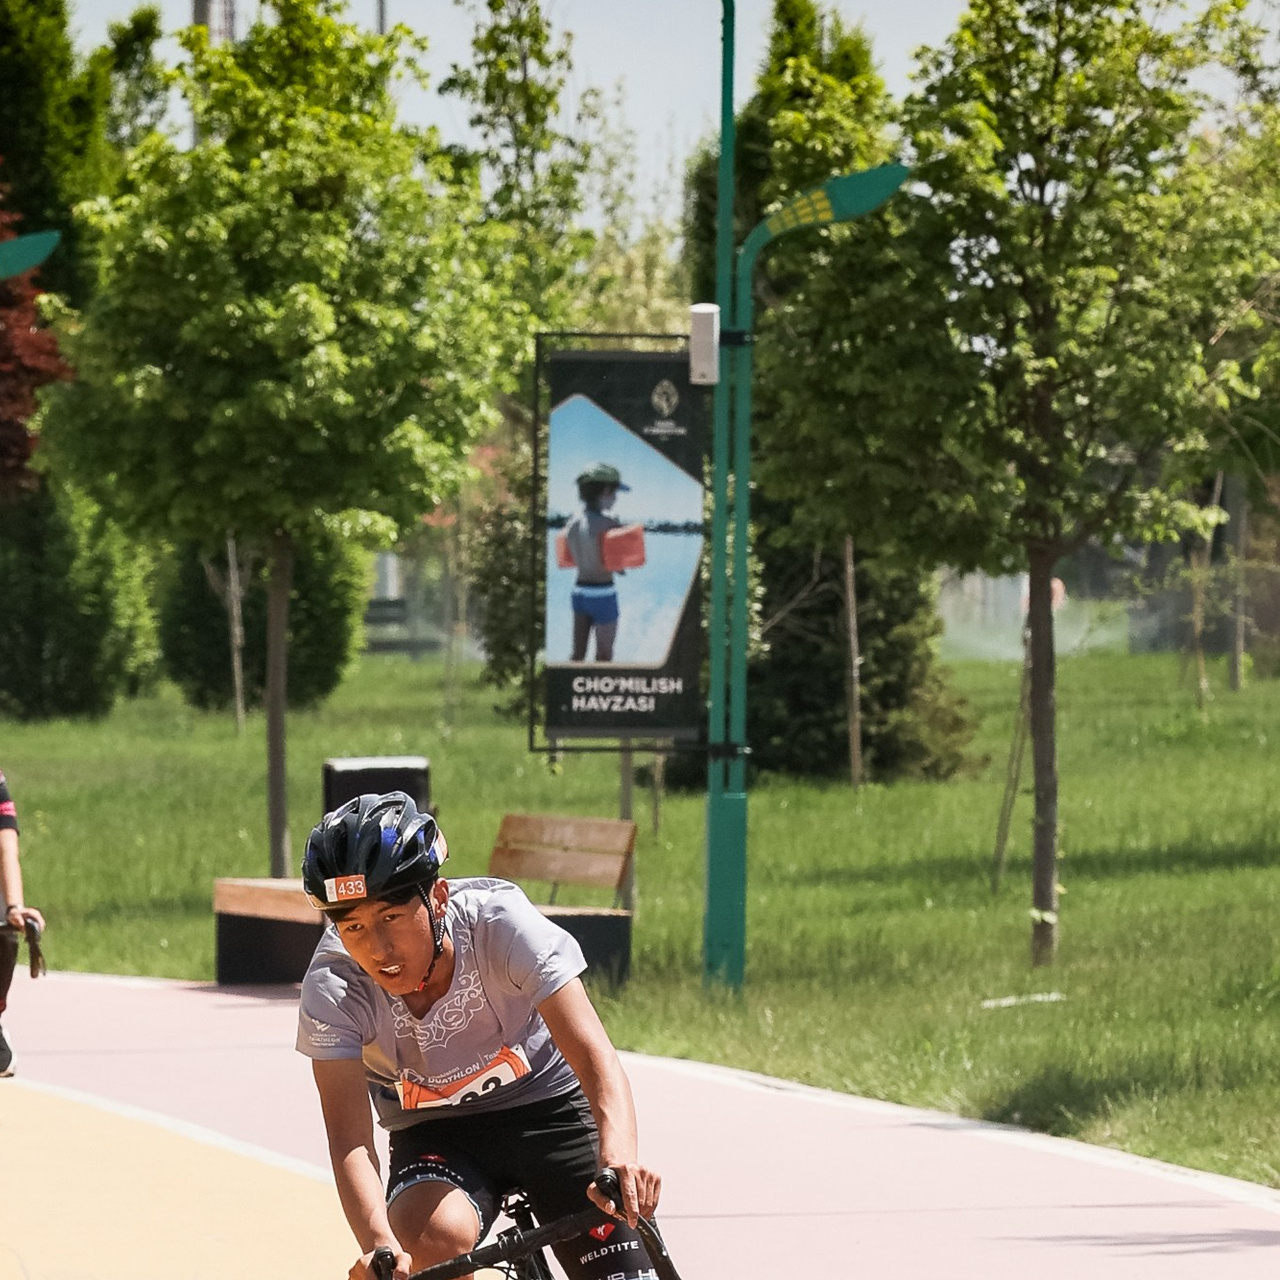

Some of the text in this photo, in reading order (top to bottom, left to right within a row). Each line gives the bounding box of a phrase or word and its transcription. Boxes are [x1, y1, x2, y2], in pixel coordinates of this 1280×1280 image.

[572, 695, 655, 712] HAVZASI
[338, 880, 364, 896] 433
[428, 1062, 480, 1084] DUATHLON
[580, 1241, 639, 1265] WELDTITE
